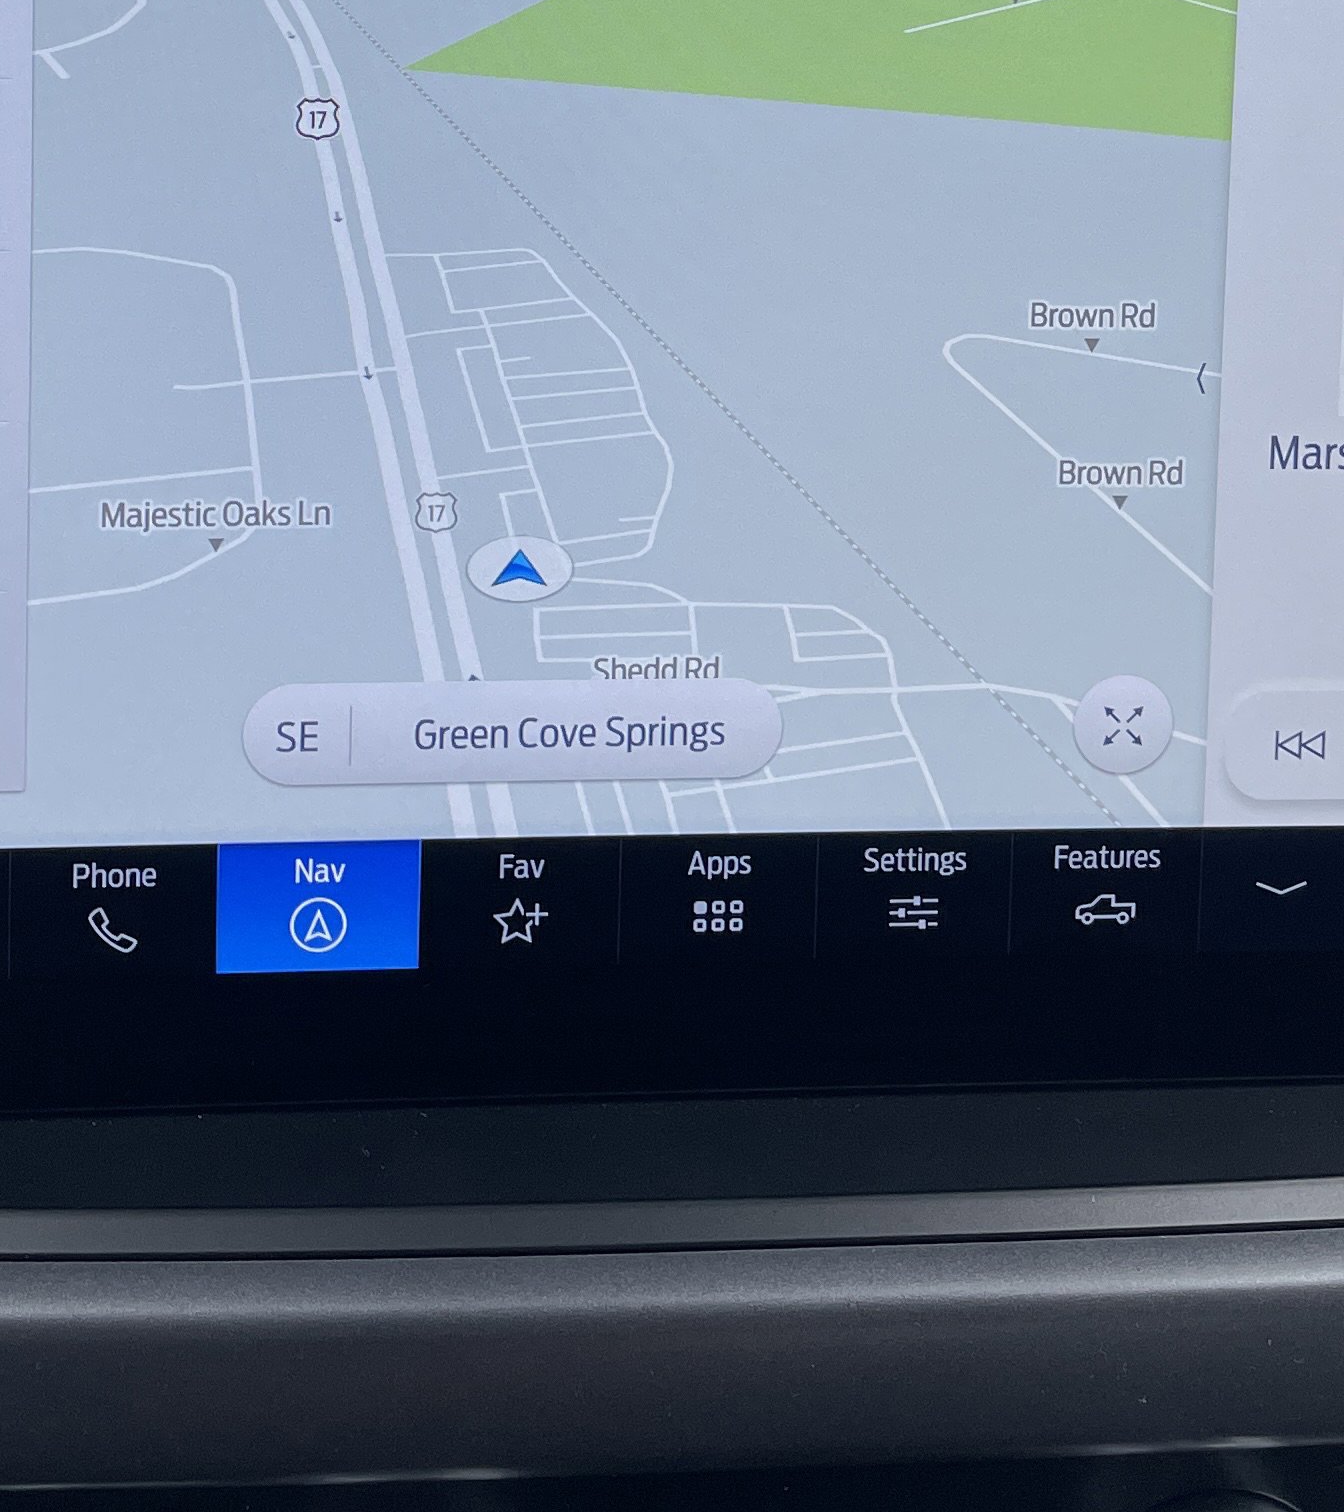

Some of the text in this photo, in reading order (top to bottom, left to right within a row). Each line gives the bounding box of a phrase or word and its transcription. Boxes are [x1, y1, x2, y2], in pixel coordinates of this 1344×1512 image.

[309, 109, 327, 129] 17
[1031, 302, 1155, 328] Brown Rd
[1059, 459, 1183, 485] Brown Rd
[100, 501, 331, 531] Majestic Oaks Ln
[428, 504, 445, 522] 17
[593, 657, 720, 679] Shedd Rd
[276, 721, 319, 752] SE
[414, 714, 726, 753] Green Cove Springs
[499, 854, 546, 880] Fav
[688, 849, 753, 883] Apps
[863, 846, 968, 877] Settings
[1054, 844, 1162, 870] Features
[73, 862, 157, 888] Phone
[294, 858, 346, 884] Nav
